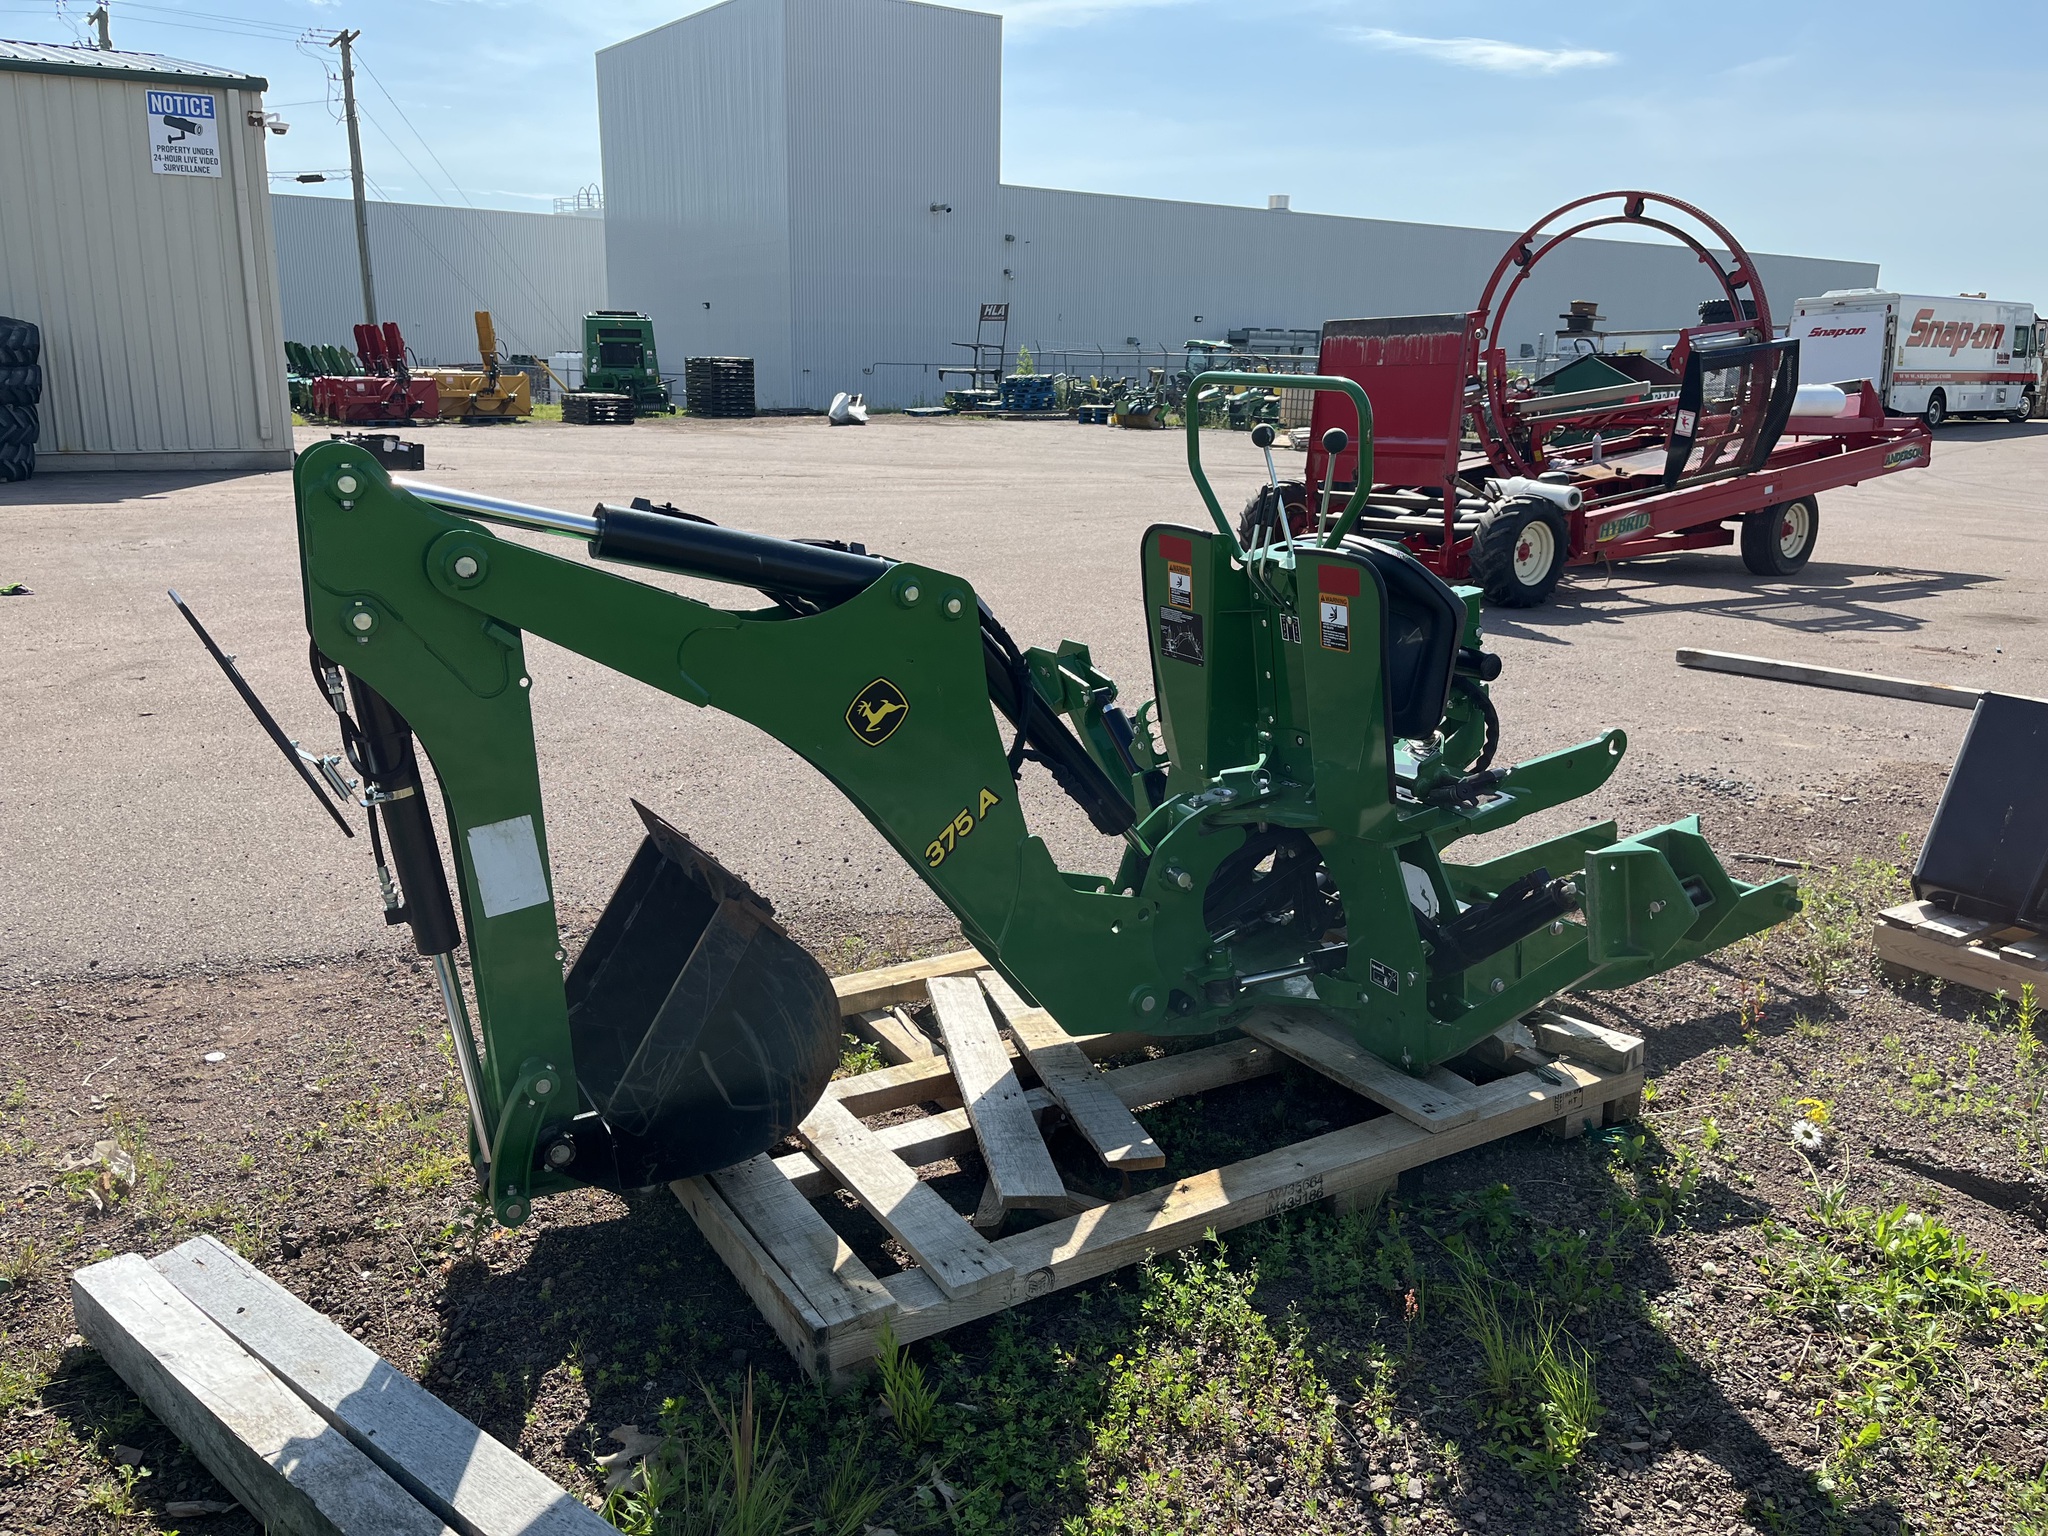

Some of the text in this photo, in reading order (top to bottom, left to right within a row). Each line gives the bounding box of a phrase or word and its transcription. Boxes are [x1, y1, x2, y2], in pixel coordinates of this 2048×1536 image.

[151, 94, 211, 116] NOTICE
[157, 145, 214, 156] PROPERTY UNDER
[154, 154, 219, 166] 24-HOUR LIVE VIDEO
[163, 163, 211, 174] SURVEILLANCE
[984, 305, 1005, 316] HLA
[1807, 327, 1867, 338] Snap-on
[1905, 308, 2005, 357] Snap-on
[1885, 446, 1924, 464] ANDERSON
[1600, 513, 1651, 538] HYBRID
[925, 787, 1001, 867] 375 A
